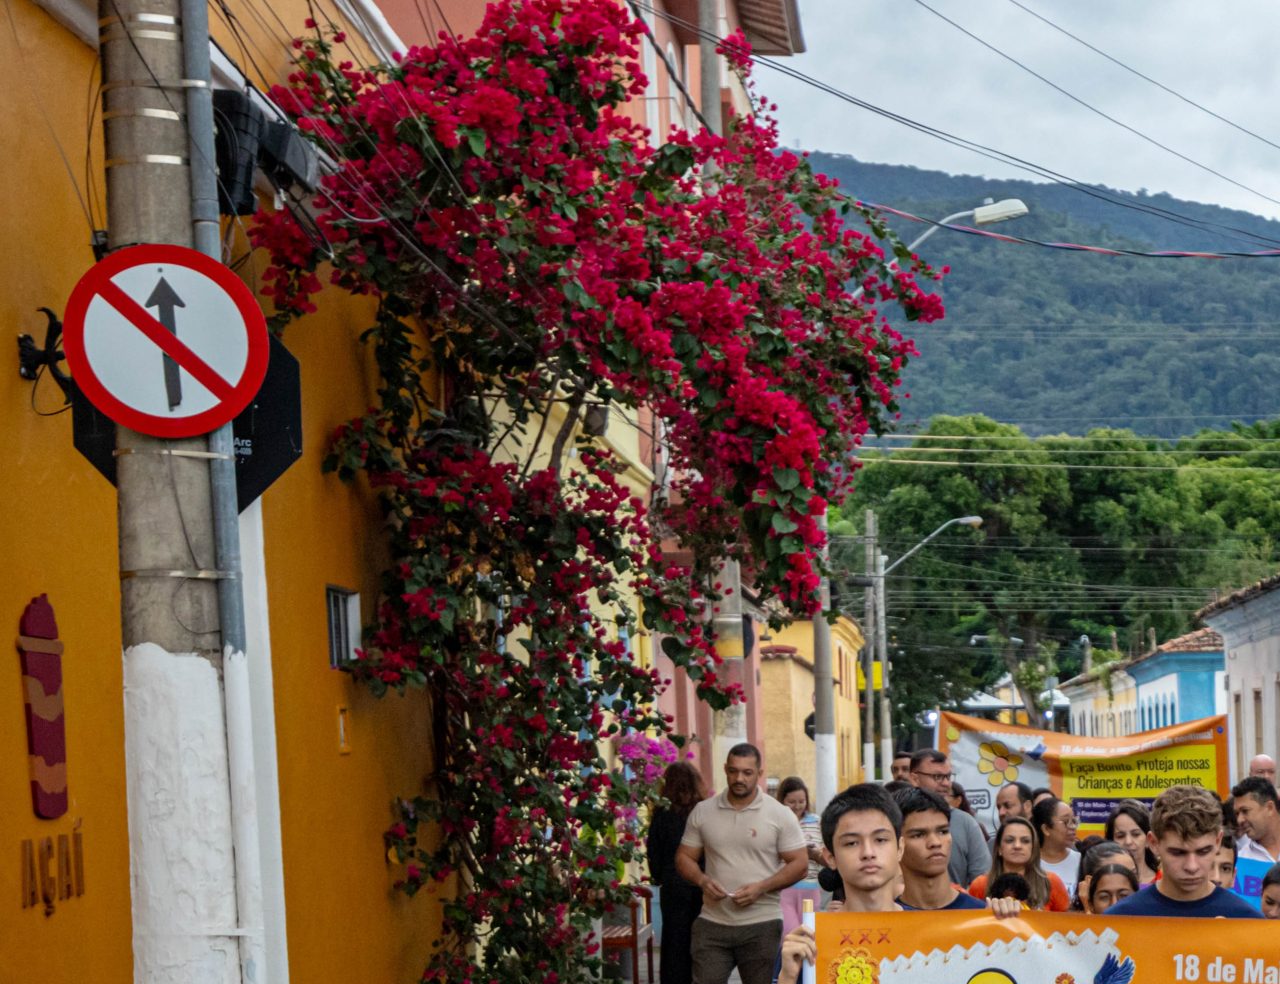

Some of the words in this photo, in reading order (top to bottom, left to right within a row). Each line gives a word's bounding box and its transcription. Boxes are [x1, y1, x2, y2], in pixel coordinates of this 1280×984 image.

[1069, 762, 1095, 775] Faça
[1097, 762, 1134, 772] Bonito.
[1137, 758, 1173, 773] Proteja
[1177, 758, 1210, 770] nossas
[1077, 774, 1123, 793] Crianças
[1126, 778, 1133, 790] e
[21, 817, 85, 918] AÇAÍ
[1173, 953, 1201, 981] 18
[1207, 956, 1237, 983] de
